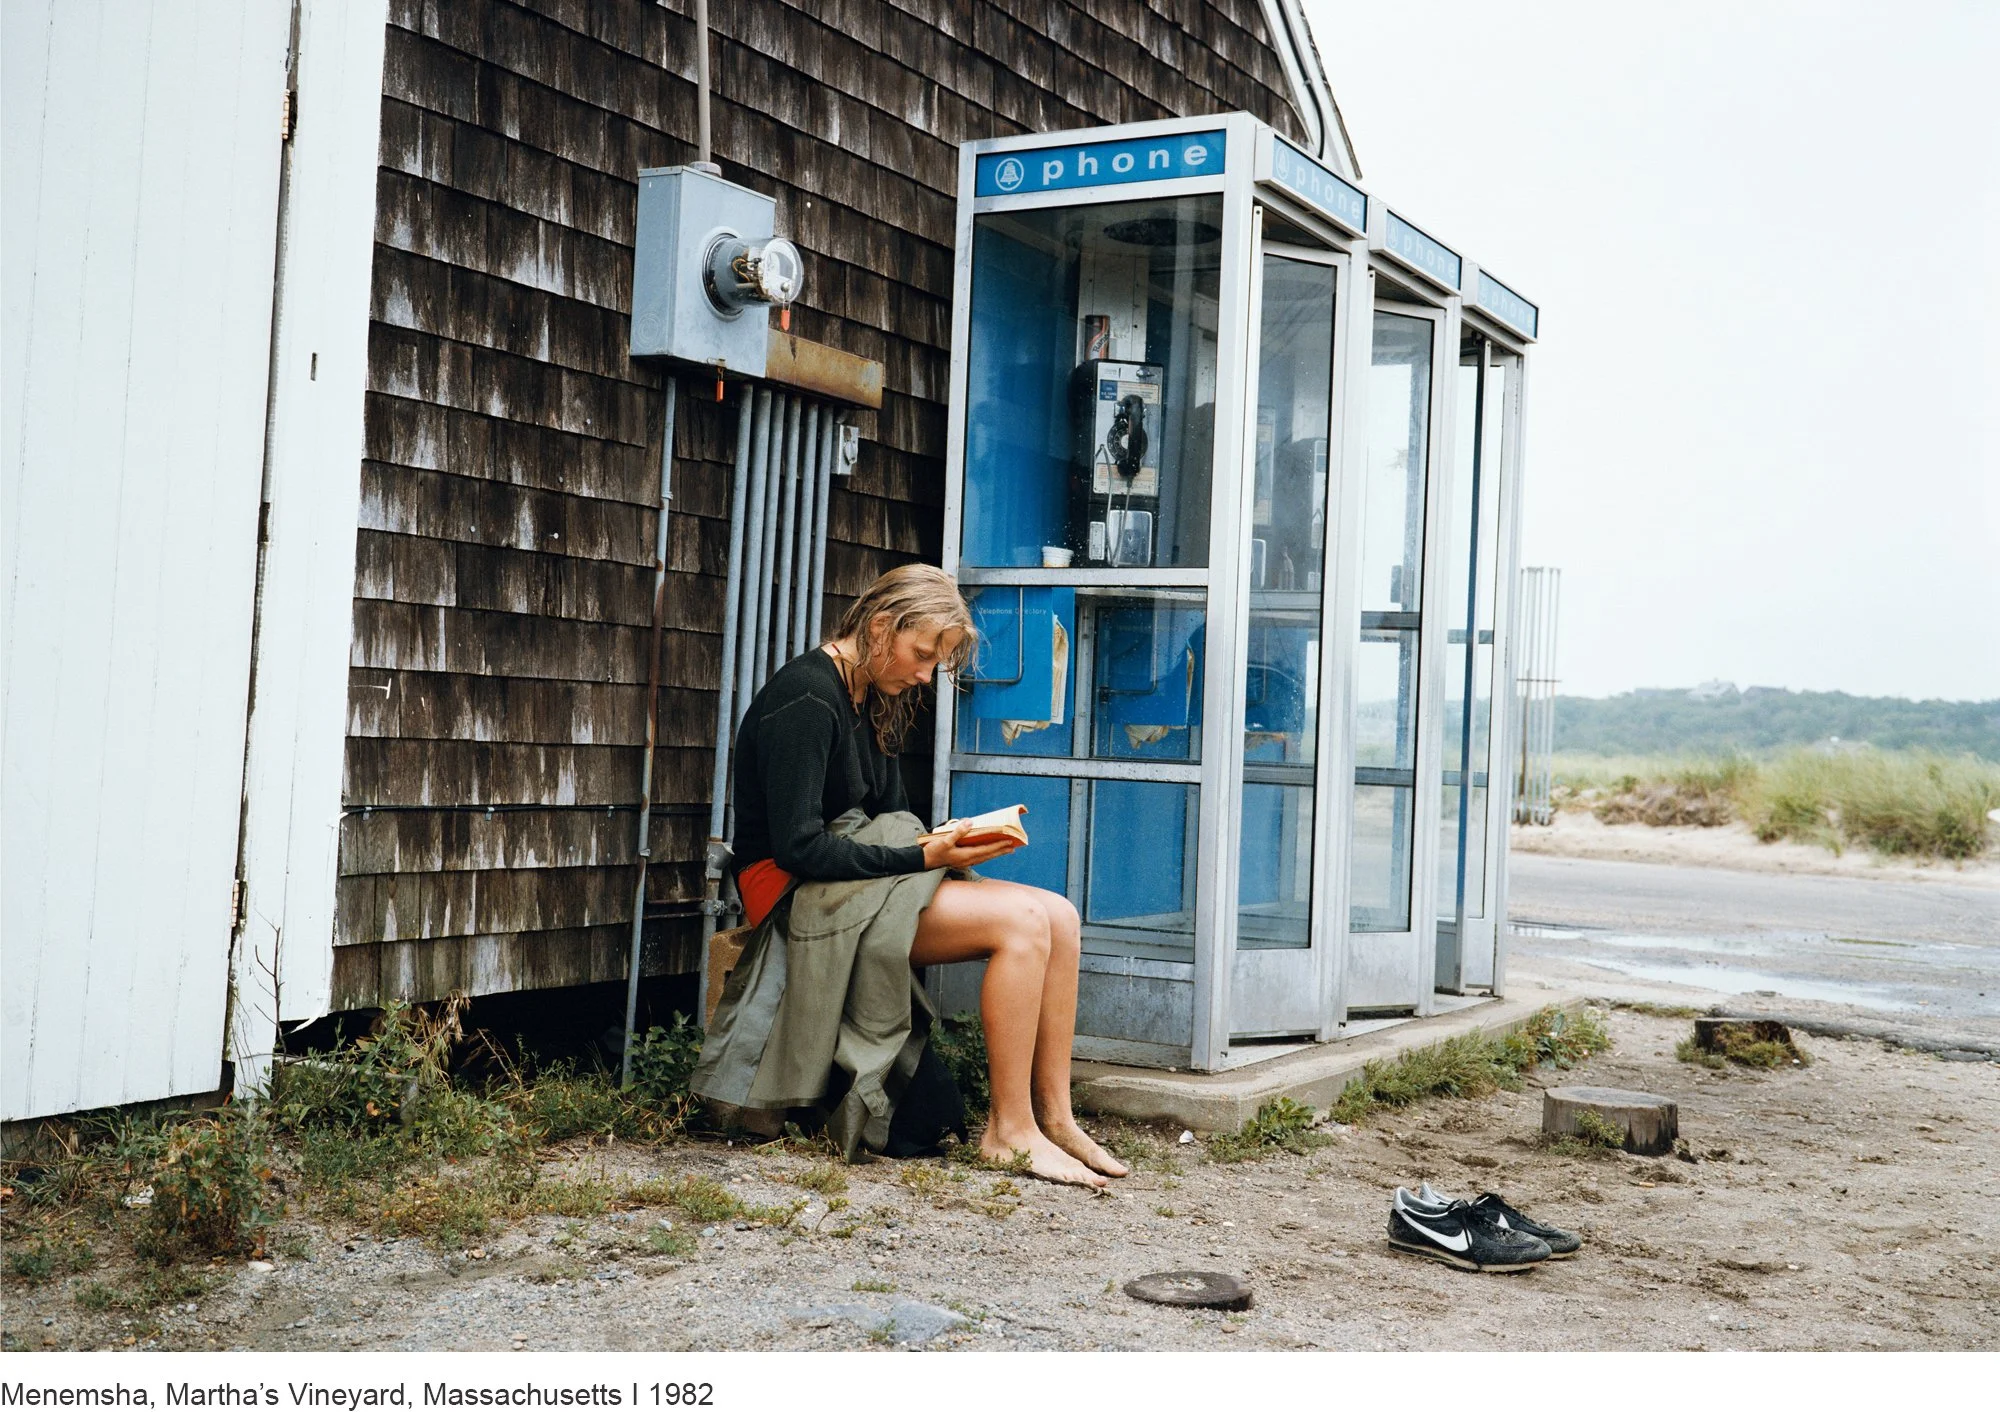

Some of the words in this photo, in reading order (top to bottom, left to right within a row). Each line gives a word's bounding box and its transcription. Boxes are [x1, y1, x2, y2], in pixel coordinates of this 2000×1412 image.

[1042, 144, 1208, 186] phone
[1295, 165, 1361, 220] phone
[1403, 233, 1457, 280] phone
[979, 607, 1013, 615] Telephone
[1014, 607, 1048, 616] Dectory
